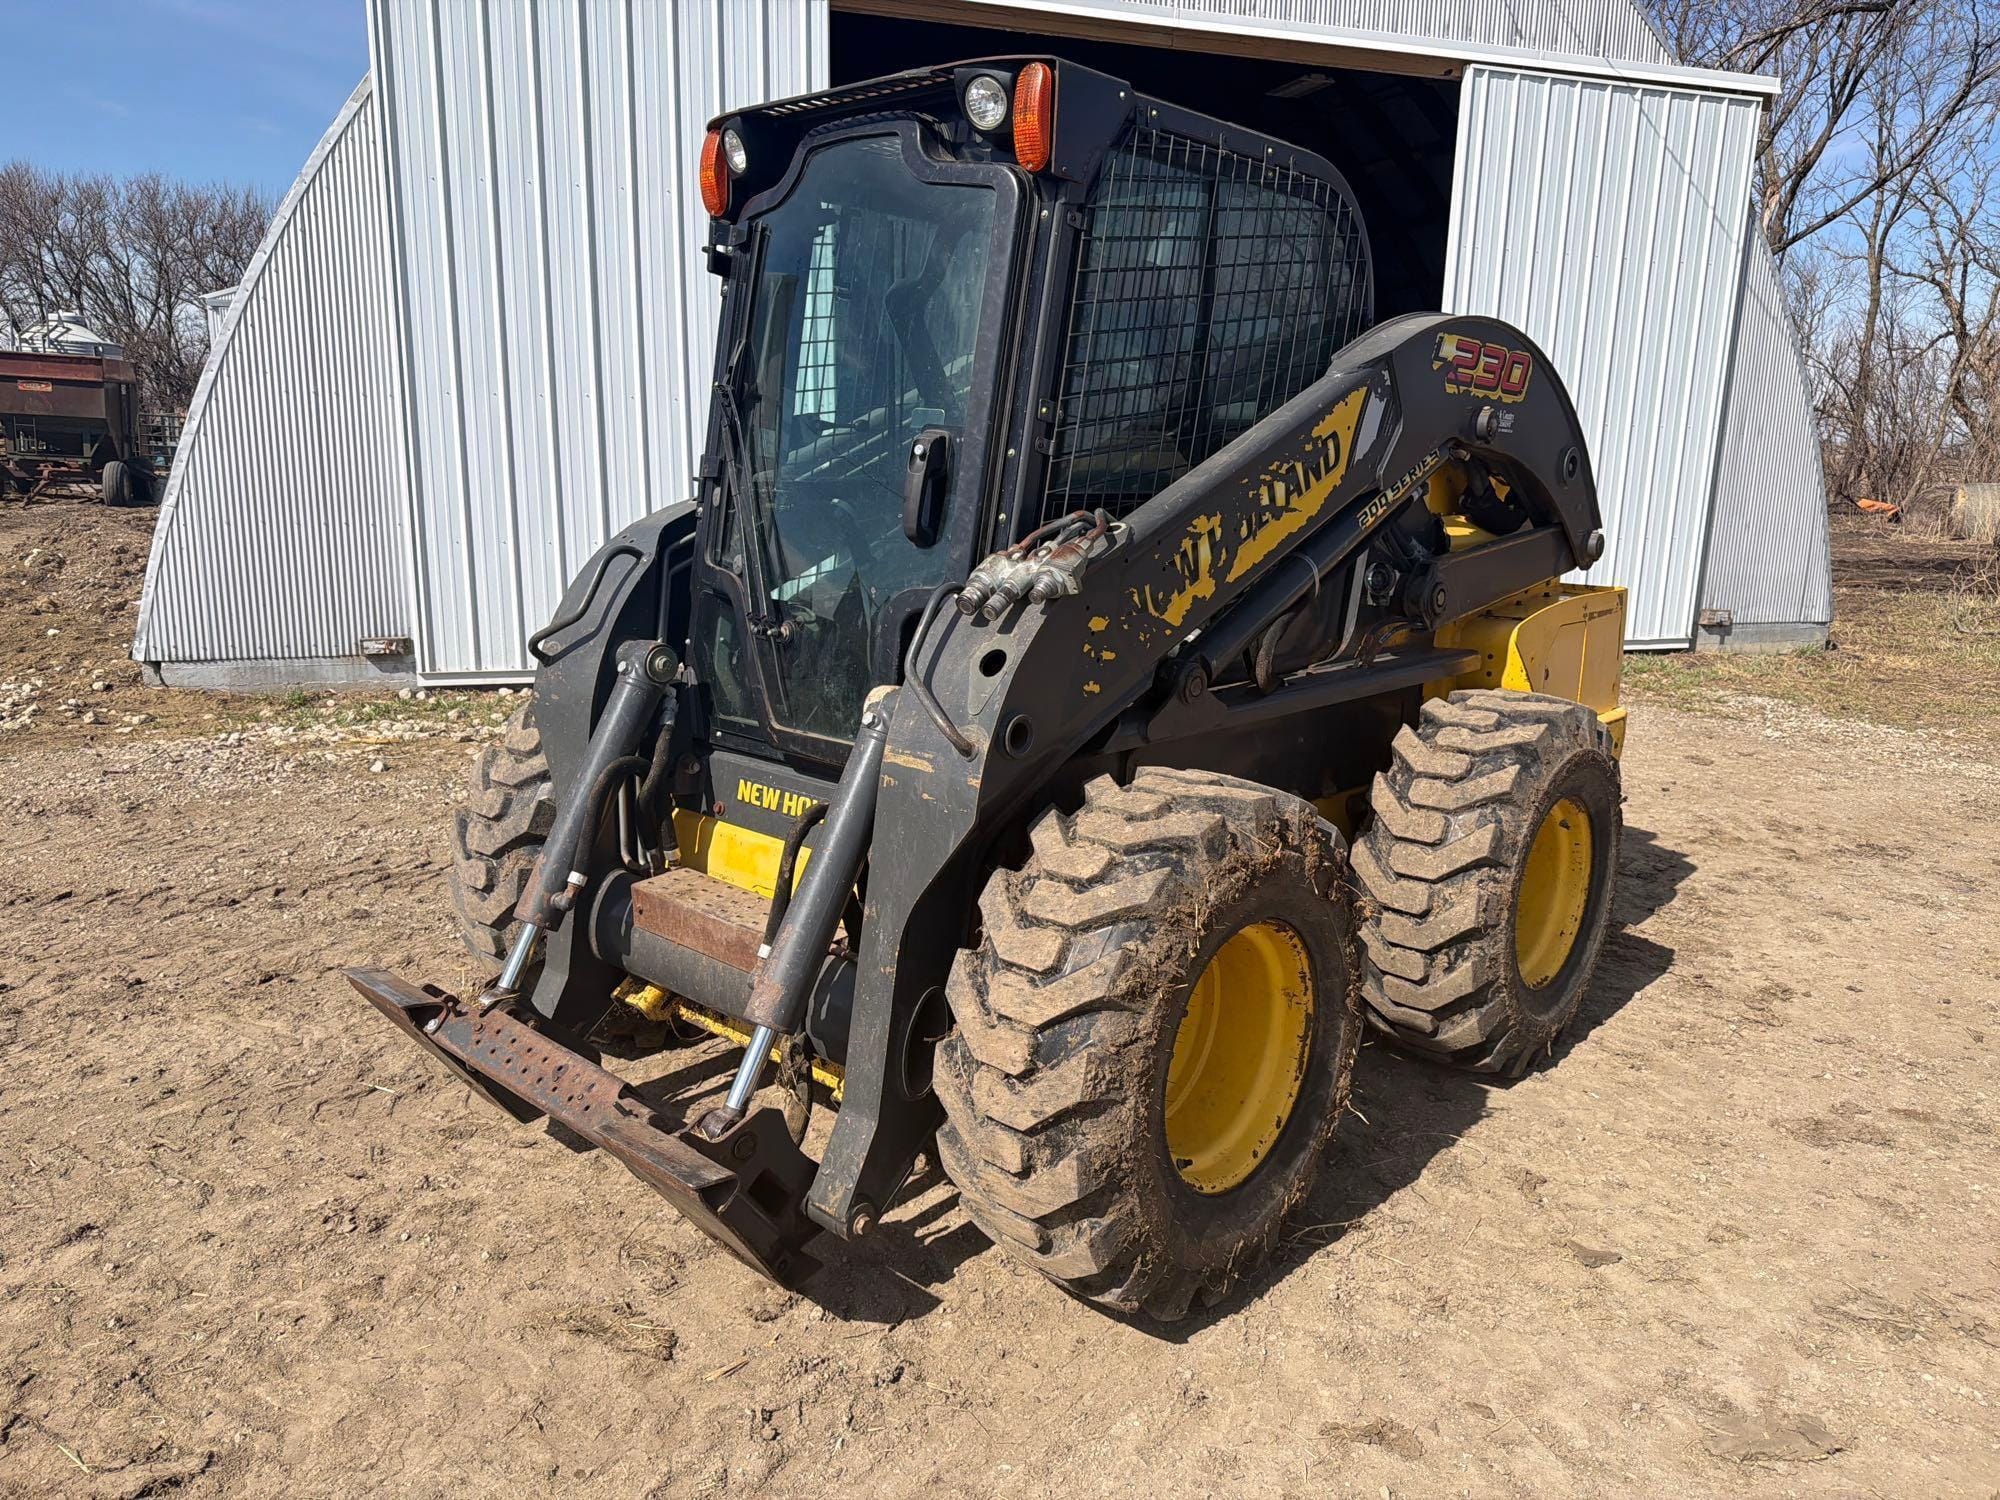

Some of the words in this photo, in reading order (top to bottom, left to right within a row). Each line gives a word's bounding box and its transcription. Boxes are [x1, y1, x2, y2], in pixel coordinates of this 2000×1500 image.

[1358, 490, 1391, 528] 200
[1391, 448, 1440, 497] SERIES
[737, 778, 781, 812] NEW
